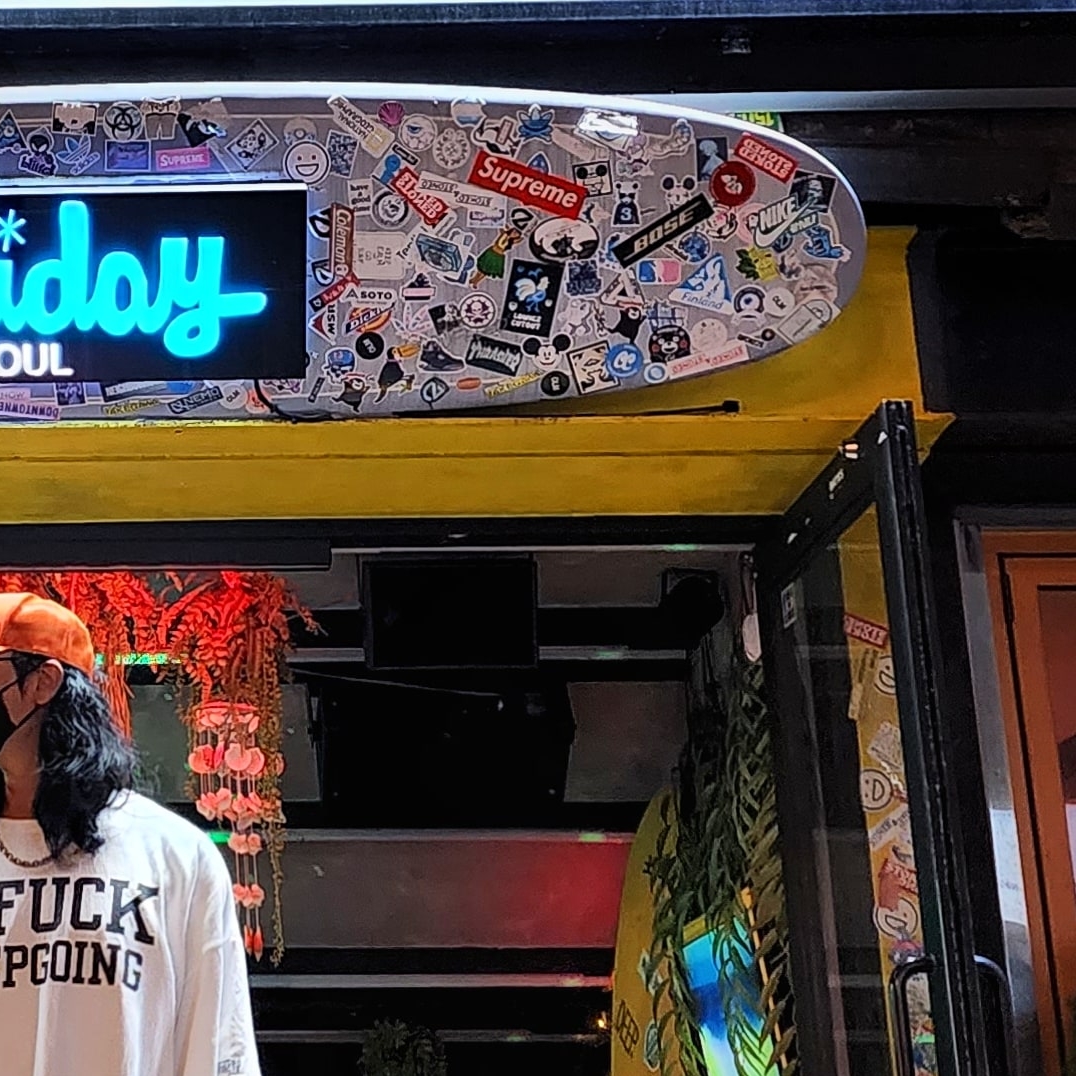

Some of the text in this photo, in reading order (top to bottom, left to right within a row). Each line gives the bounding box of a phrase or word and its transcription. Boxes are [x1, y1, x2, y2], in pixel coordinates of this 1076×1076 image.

[477, 156, 579, 208] Supreme
[634, 210, 694, 252] BOSE
[758, 196, 797, 232] NIKE
[335, 209, 352, 265] Coleman
[360, 291, 393, 300] SOTO
[681, 290, 724, 310] Finland
[327, 303, 336, 336] MSR
[185, 386, 222, 407] NEMO
